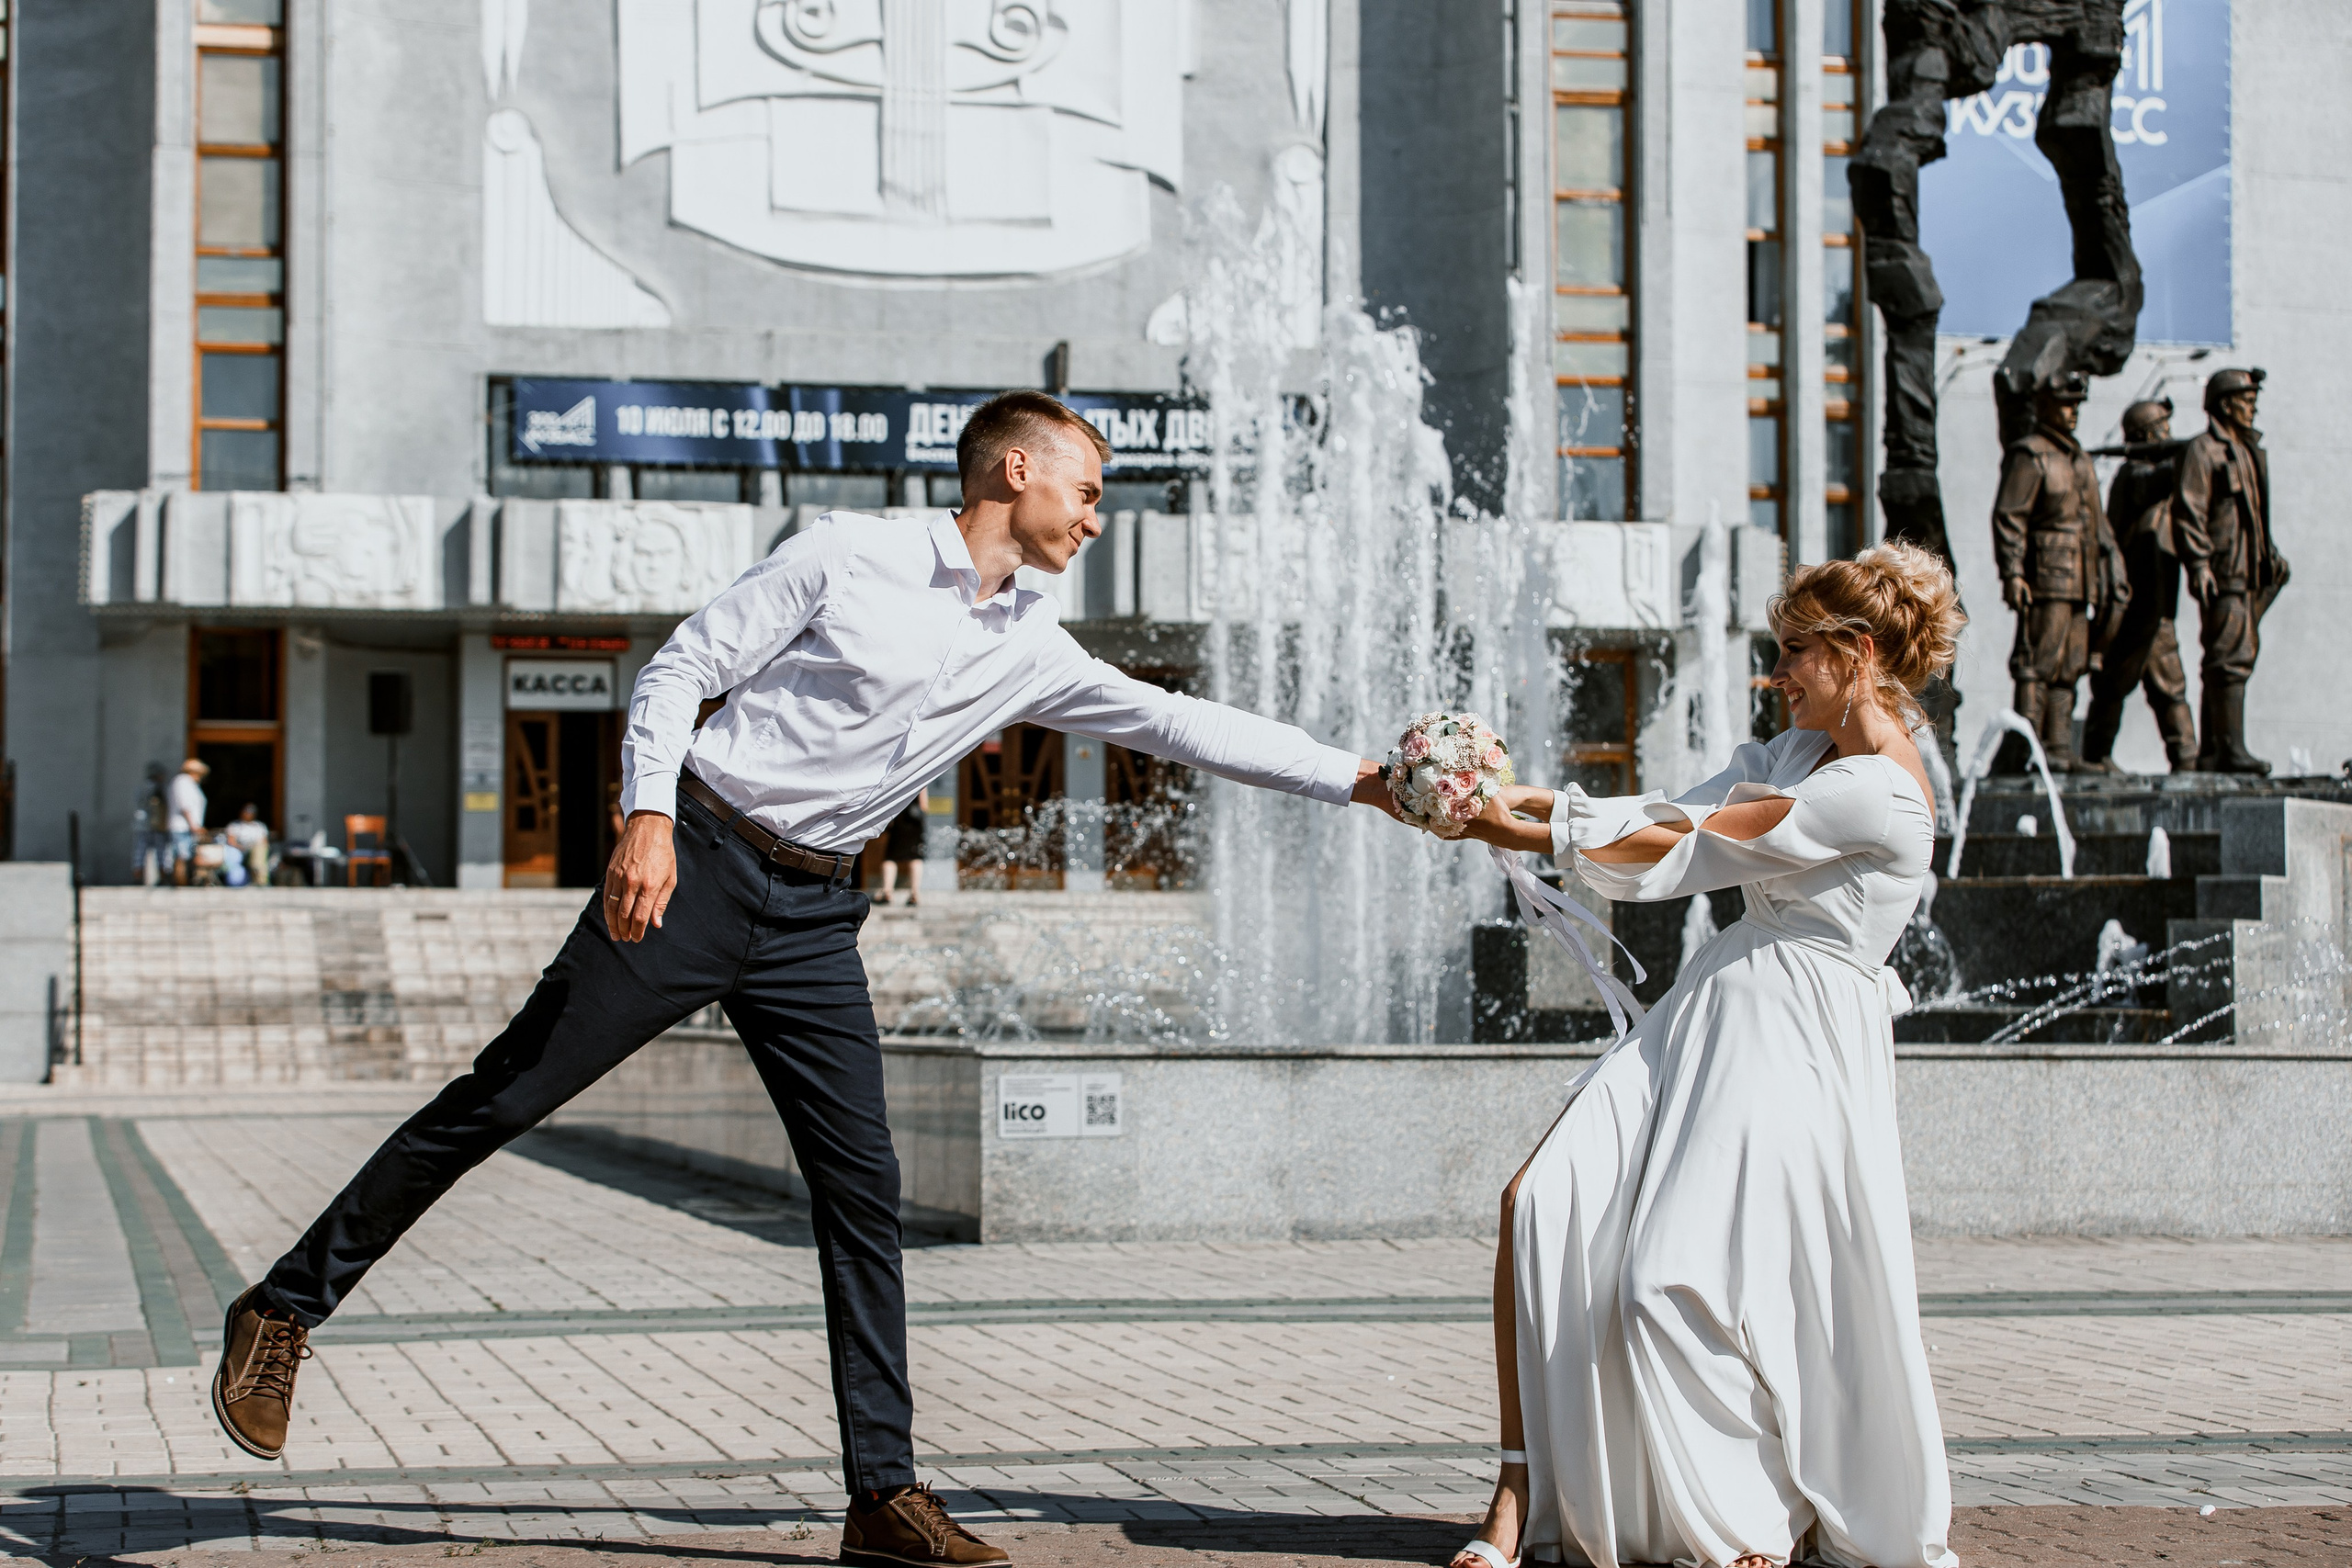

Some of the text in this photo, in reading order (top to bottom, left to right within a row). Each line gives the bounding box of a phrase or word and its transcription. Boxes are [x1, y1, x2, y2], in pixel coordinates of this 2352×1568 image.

[1950, 90, 2168, 145] КУЗСС
[616, 404, 643, 436] 10
[644, 406, 711, 439] ИЮЛЯ
[711, 408, 730, 439] С
[732, 409, 792, 441] 12.00
[792, 411, 826, 445] ДО
[906, 402, 979, 446] ДЕН
[513, 672, 608, 695] КАССА
[1003, 1102, 1046, 1122] lico
